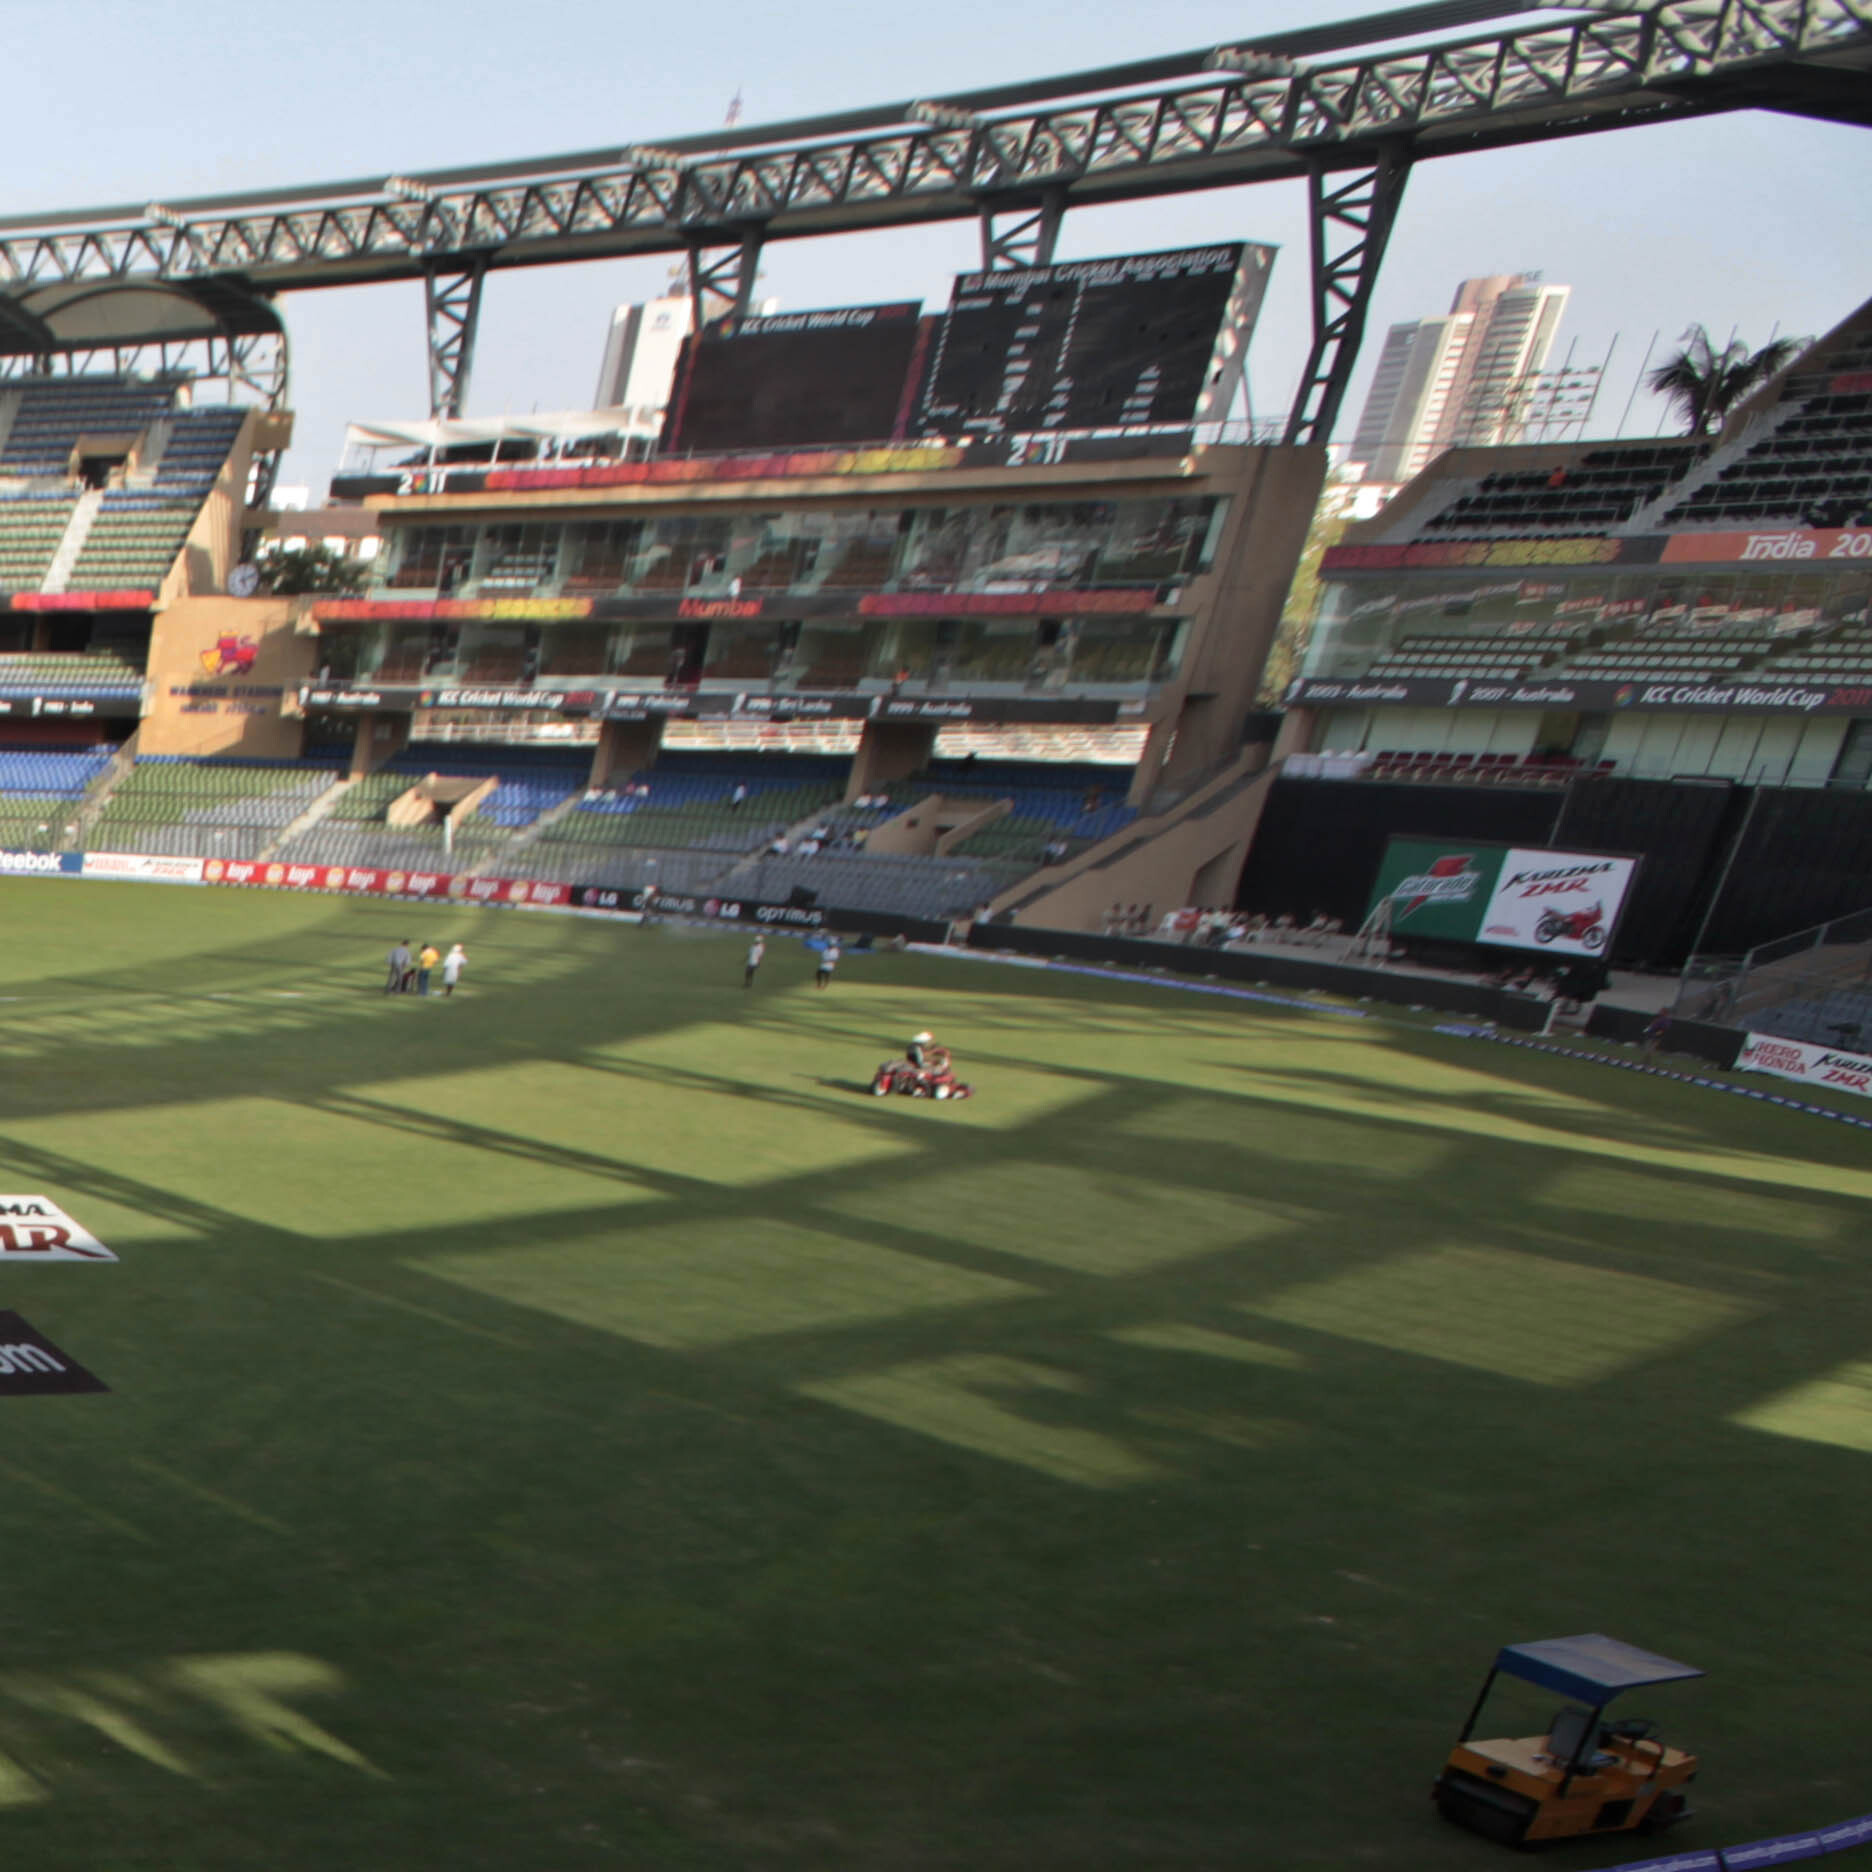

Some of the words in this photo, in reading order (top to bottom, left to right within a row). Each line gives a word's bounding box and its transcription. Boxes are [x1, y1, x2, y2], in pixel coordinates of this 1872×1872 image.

[982, 268, 1051, 290] Mumbai
[1055, 263, 1119, 283] Cricket
[1120, 249, 1231, 274] Association
[762, 315, 805, 334] Cricket
[806, 311, 846, 331] World
[847, 309, 876, 328] Cup
[1739, 531, 1817, 560] India
[677, 595, 764, 618] Mumbai
[459, 690, 501, 706] Cricket
[502, 690, 540, 706] World
[1512, 685, 1576, 703] Australia
[1641, 686, 1673, 703] ICC
[1673, 686, 1734, 704] Cricket
[1736, 687, 1789, 706] World
[1789, 688, 1825, 711] Cup
[599, 892, 618, 907] LG
[720, 903, 739, 918] LG
[1756, 1041, 1802, 1060] HERO
[1756, 1053, 1806, 1075] HONDA
[1821, 1070, 1870, 1092] ZMR
